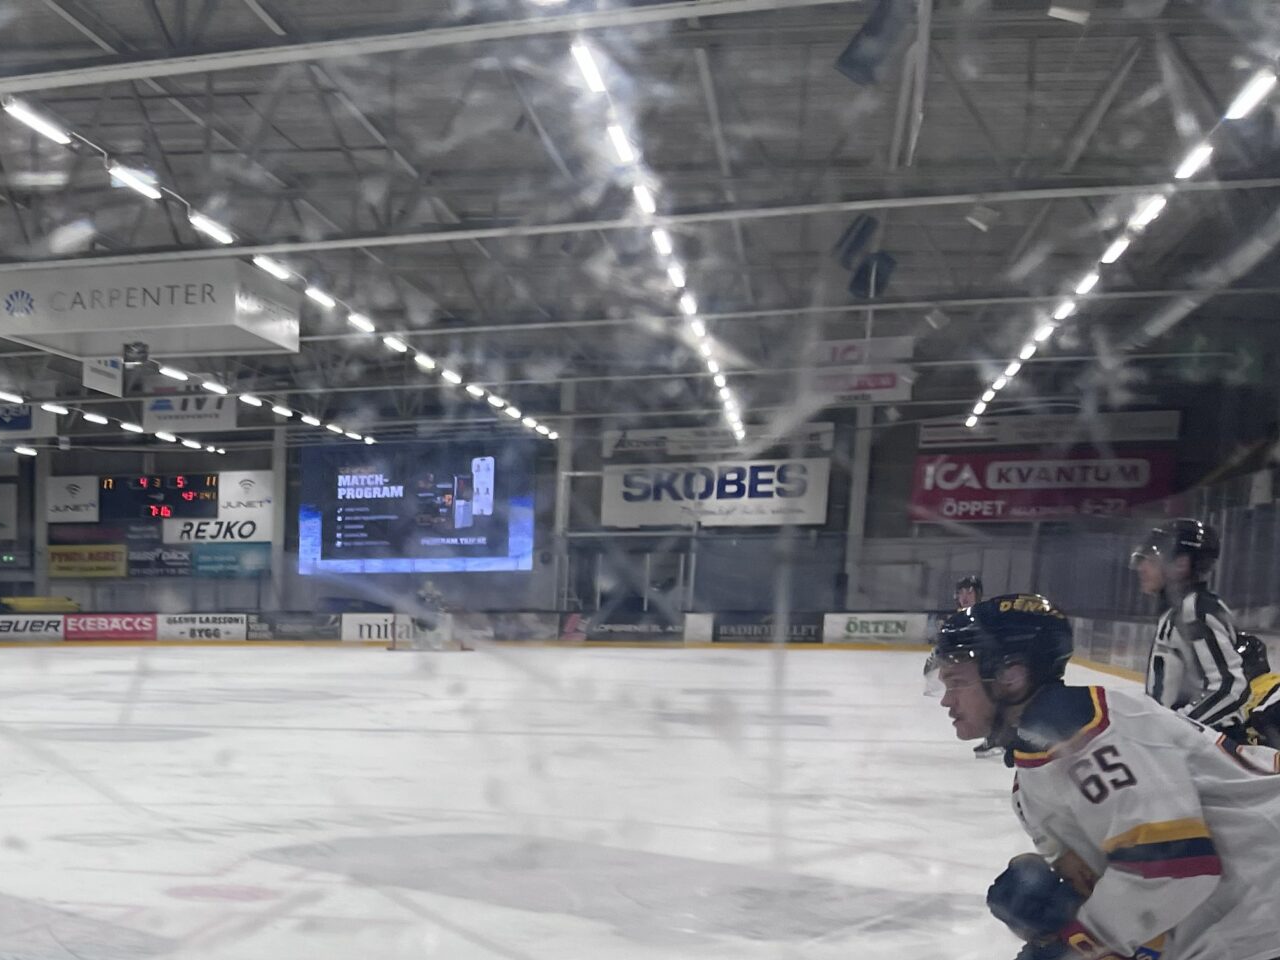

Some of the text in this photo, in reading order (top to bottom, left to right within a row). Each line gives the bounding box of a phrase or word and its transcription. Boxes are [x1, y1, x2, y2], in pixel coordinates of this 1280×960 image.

[49, 283, 217, 312] CARPENTER
[621, 463, 809, 503] SKOBES
[923, 462, 1141, 491] ICA KVANTUM
[337, 486, 404, 500] PROGRAM
[941, 496, 1008, 517] ÖPPET
[179, 520, 257, 541] REJKO
[189, 628, 221, 639] BYGG
[358, 617, 422, 640] mita
[846, 616, 908, 633] ÖRTEN
[1067, 744, 1138, 805] 65
